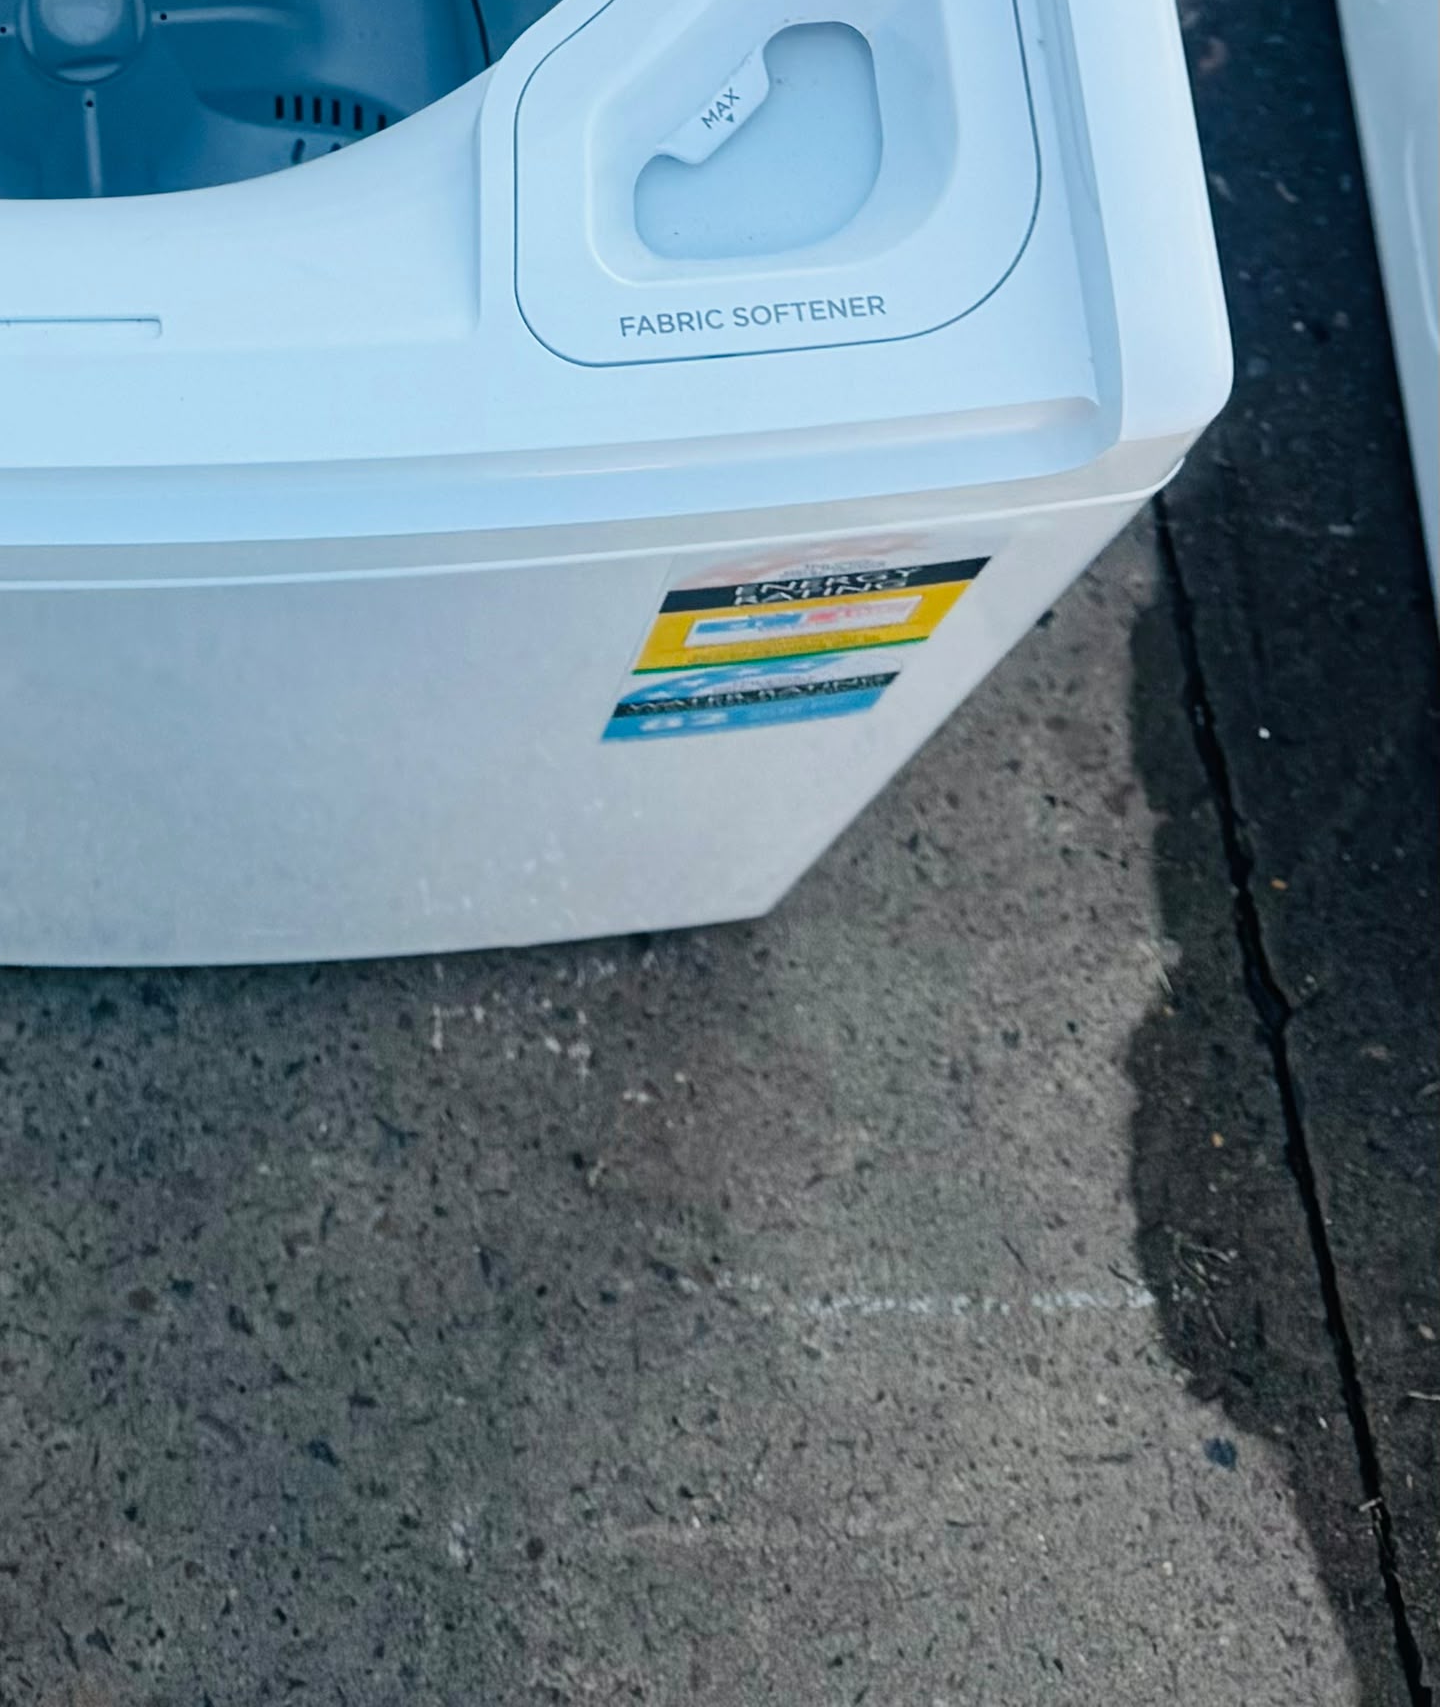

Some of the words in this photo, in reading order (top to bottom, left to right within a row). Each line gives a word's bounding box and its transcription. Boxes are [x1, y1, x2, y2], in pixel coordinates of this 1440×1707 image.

[701, 86, 740, 129] MAX
[620, 308, 725, 338] FABRIC
[732, 295, 887, 328] SOFTENER
[734, 565, 923, 596] ENERGY
